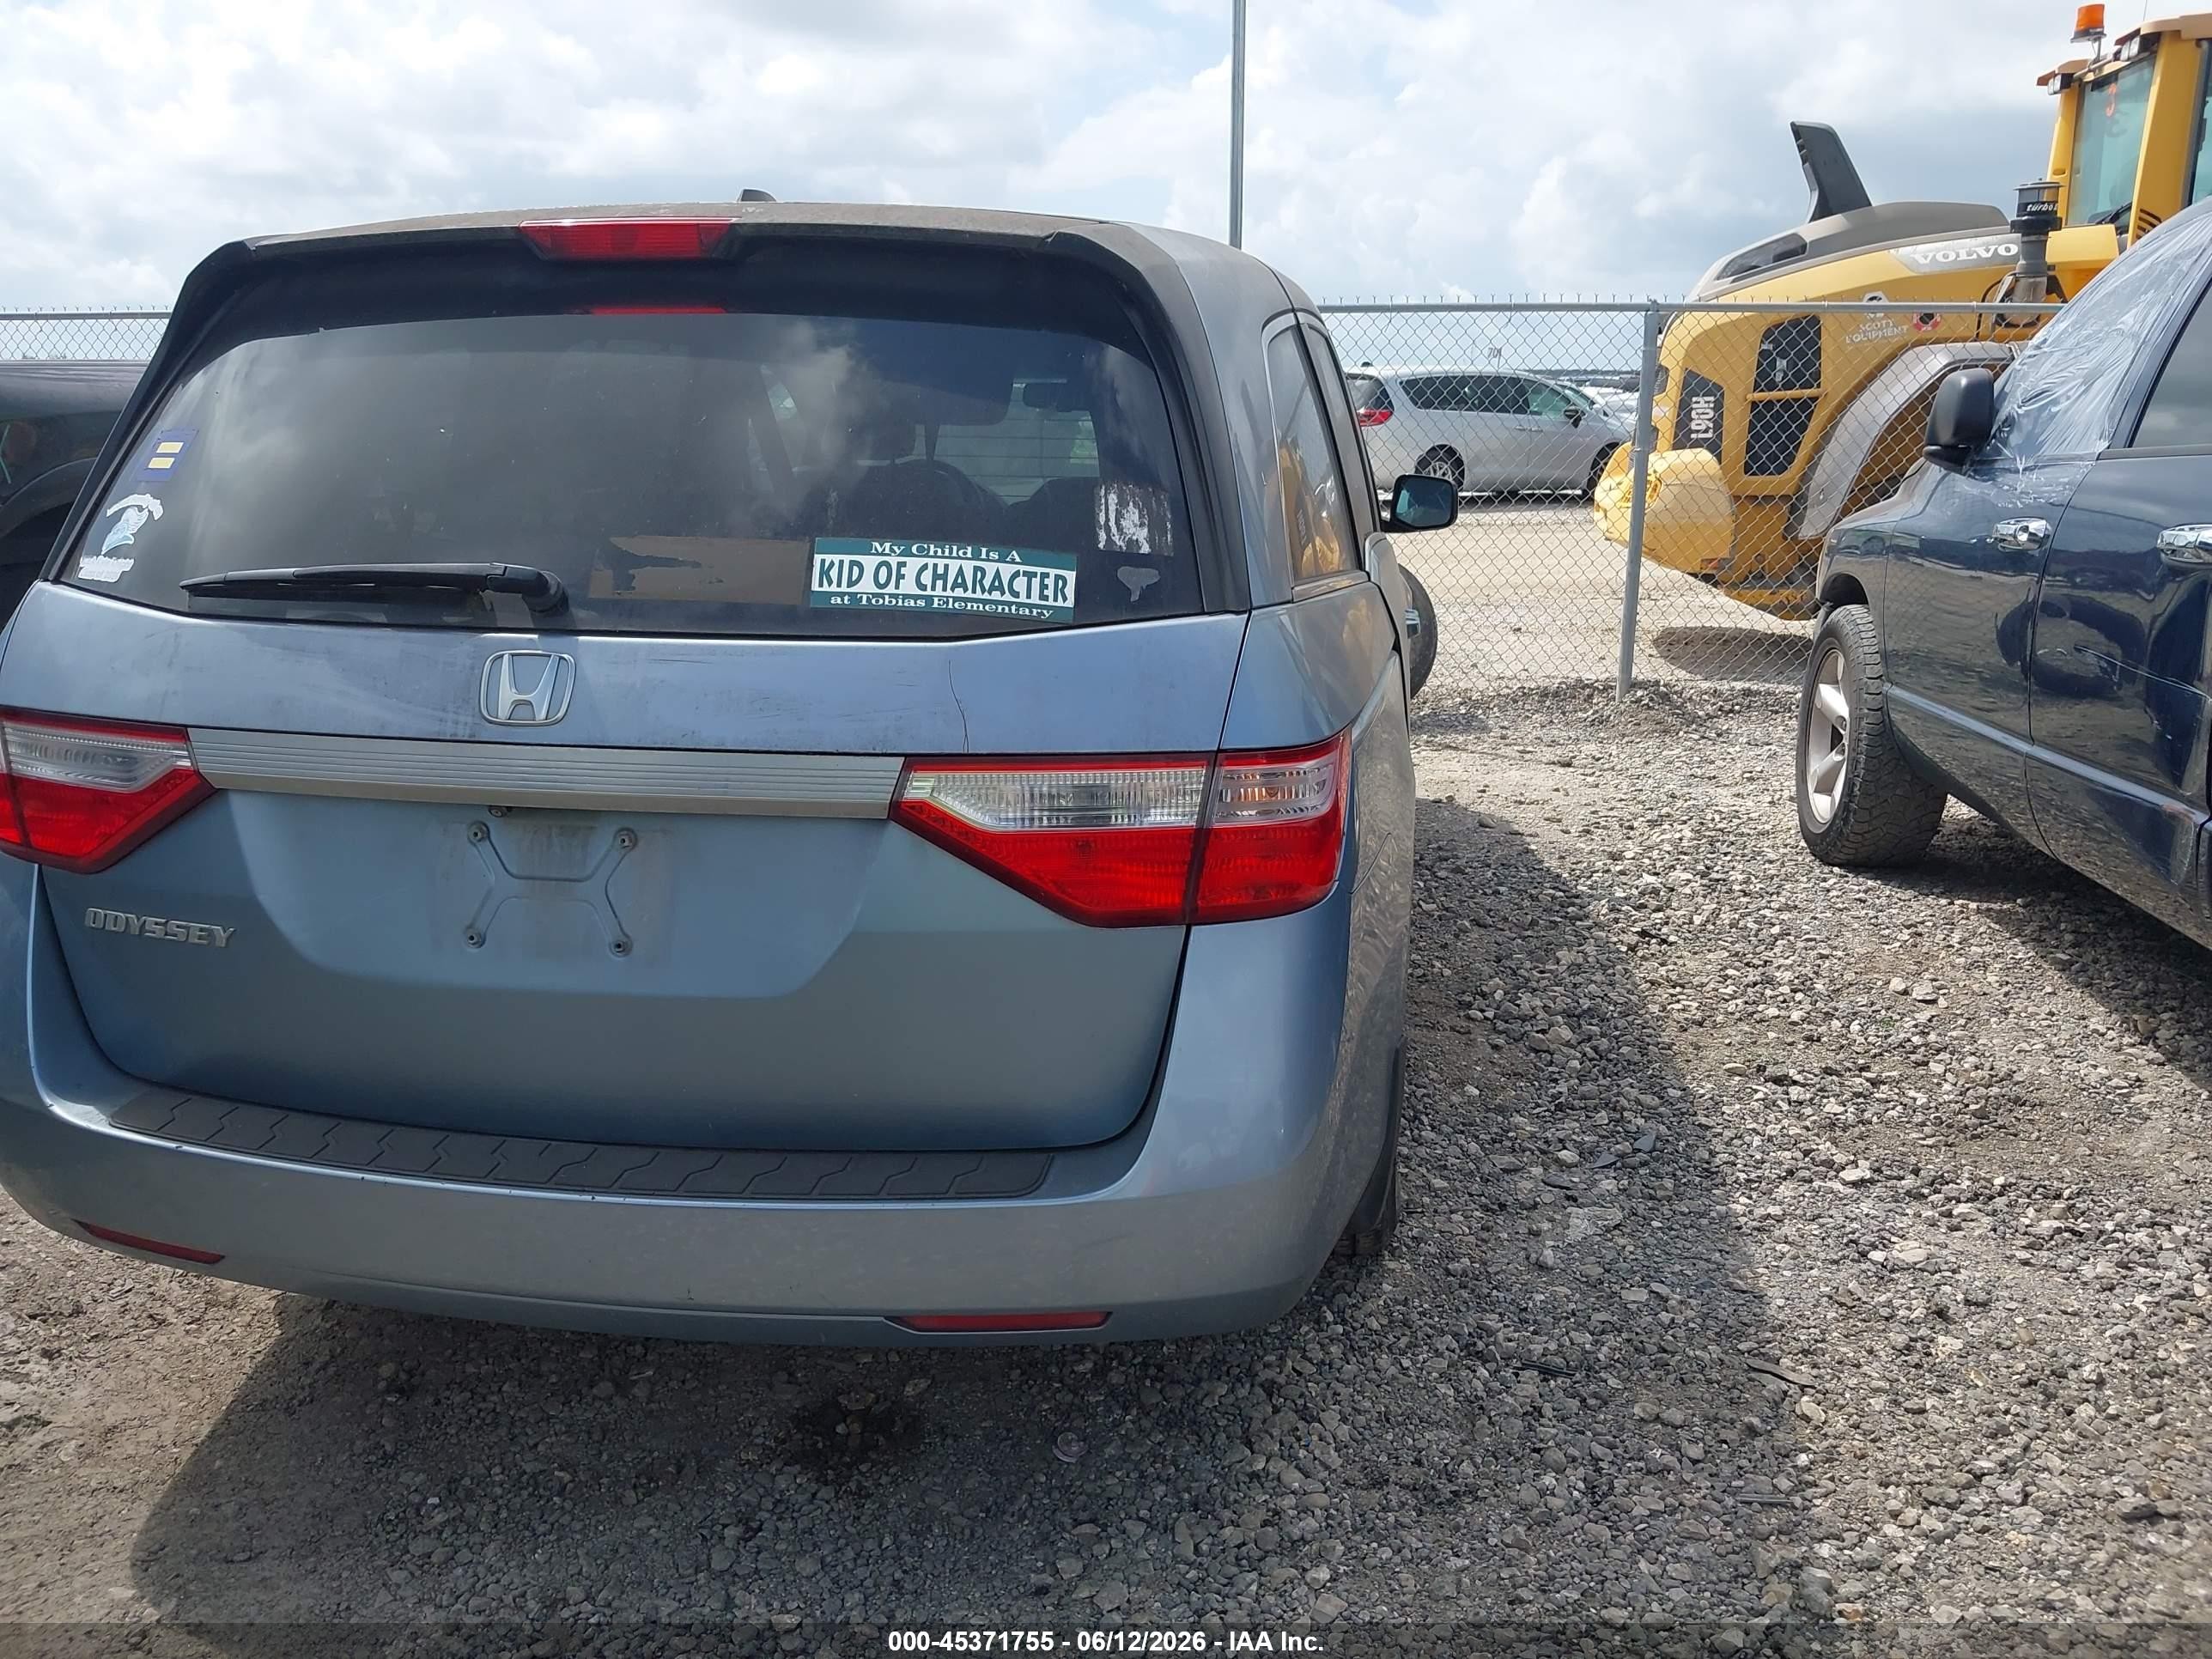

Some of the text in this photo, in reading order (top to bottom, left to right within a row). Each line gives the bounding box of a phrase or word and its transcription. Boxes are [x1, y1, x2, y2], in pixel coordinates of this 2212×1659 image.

[1911, 243, 2018, 264] VOLVO
[870, 541, 1023, 562] My Child Is A
[817, 557, 1070, 605] KID OF CHARACTER
[830, 593, 1054, 619] at Tobias Elementary
[83, 907, 236, 948] ODYSSEY
